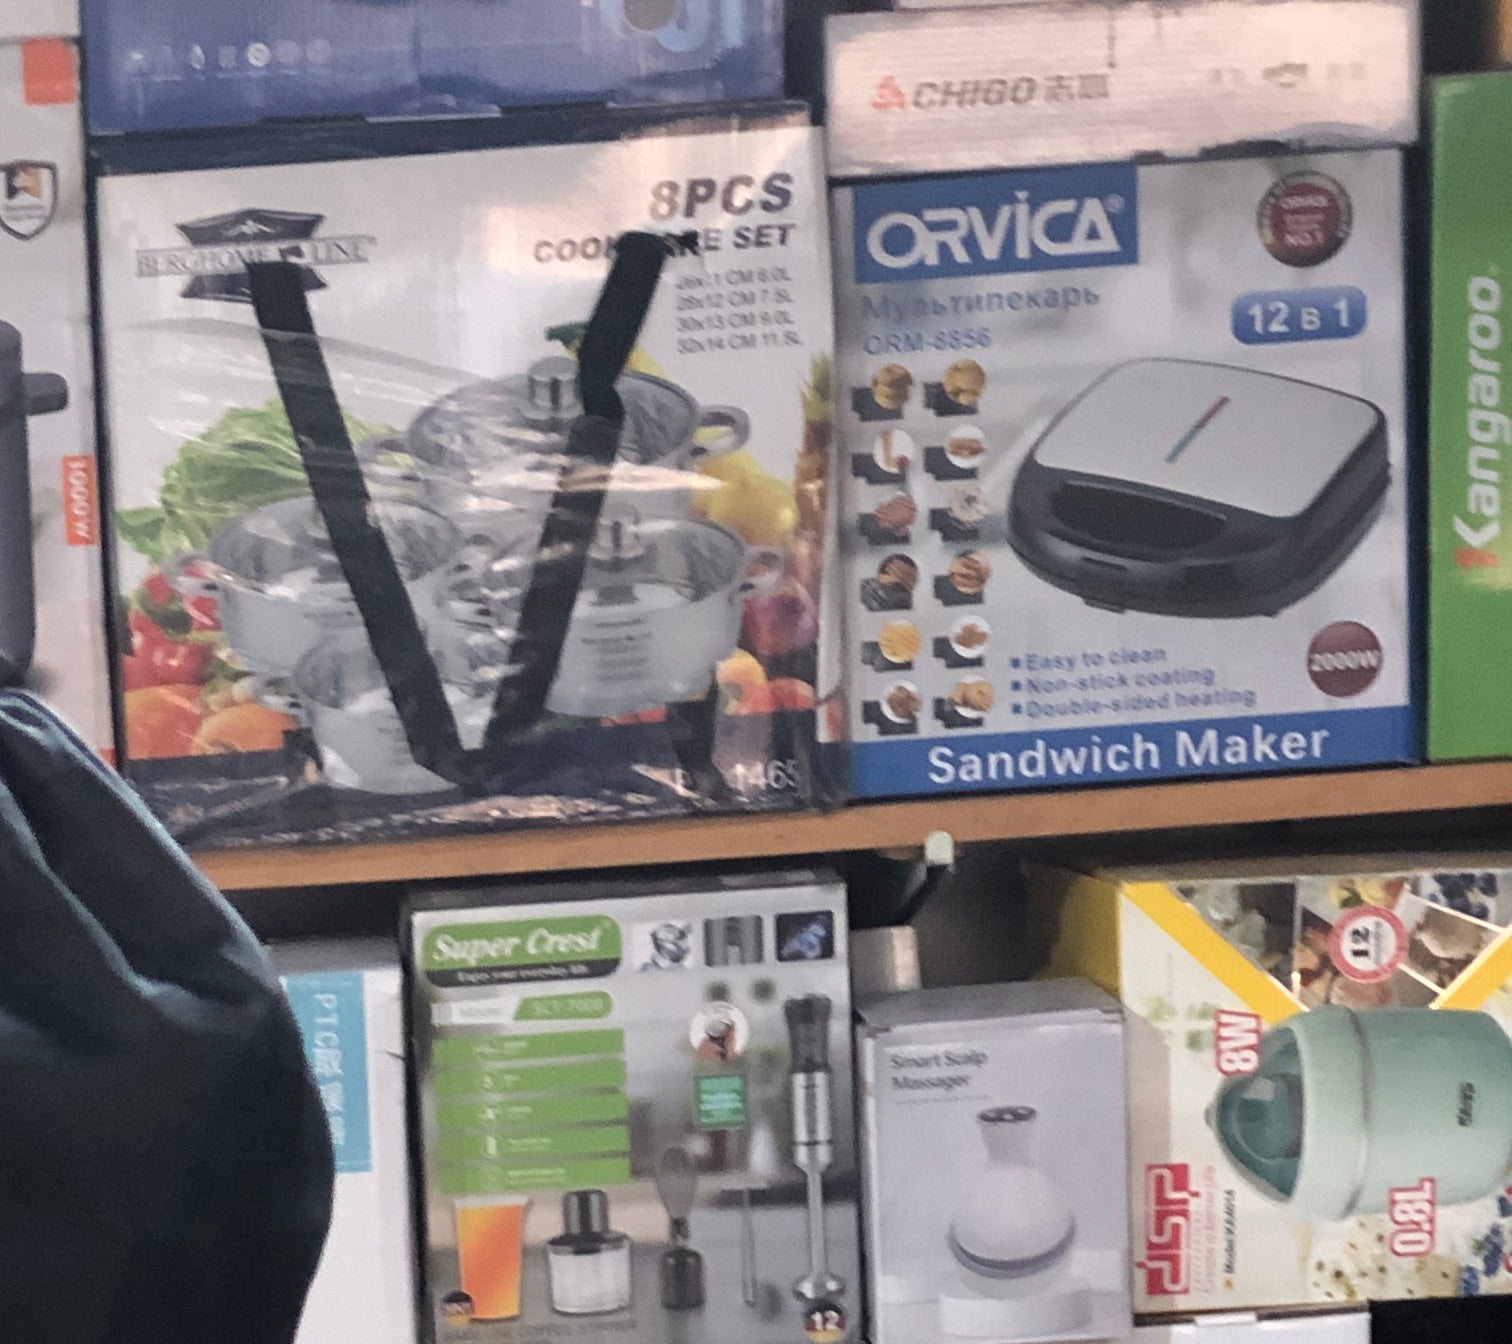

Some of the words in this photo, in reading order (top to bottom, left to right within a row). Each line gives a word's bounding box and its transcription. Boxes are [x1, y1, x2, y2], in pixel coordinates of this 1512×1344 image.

[912, 76, 1037, 109] CHIGO
[649, 171, 794, 221] 8PCS
[733, 223, 796, 250] SET
[867, 189, 1122, 269] ORVICA
[1247, 301, 1289, 335] 12
[1334, 298, 1350, 329] 1
[1452, 274, 1512, 571] Kangaroo
[1025, 653, 1077, 672] Easy
[1081, 651, 1104, 668] to
[1109, 647, 1167, 665] clean
[927, 734, 1160, 785] Sandwich
[1175, 723, 1331, 770] Maker
[432, 933, 522, 967] Super
[527, 926, 602, 955] Crest
[1219, 1011, 1259, 1074] 8W
[1392, 1179, 1432, 1255] 0.8L
